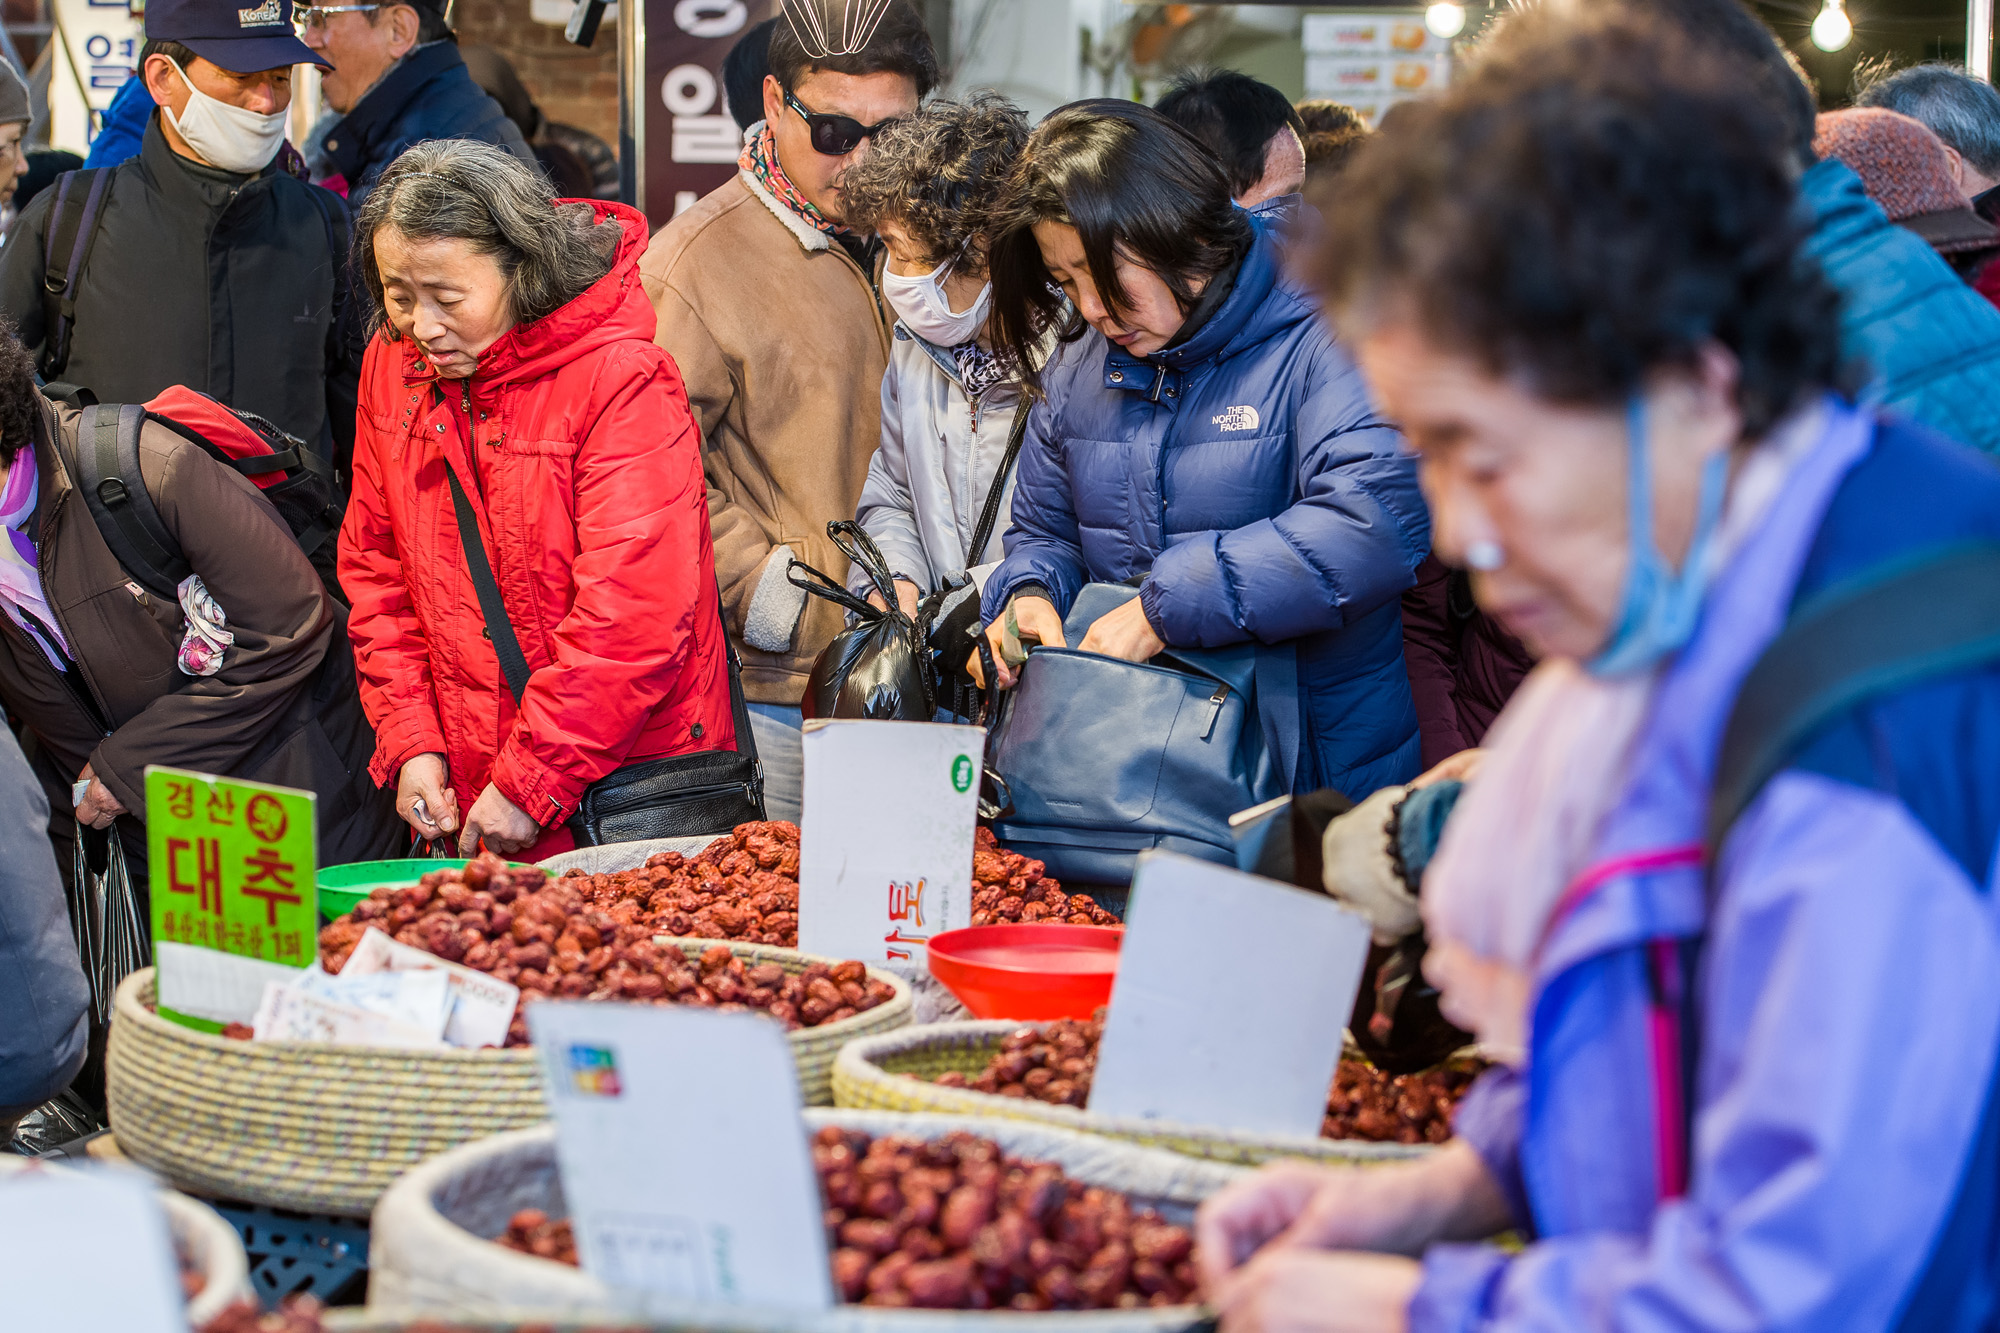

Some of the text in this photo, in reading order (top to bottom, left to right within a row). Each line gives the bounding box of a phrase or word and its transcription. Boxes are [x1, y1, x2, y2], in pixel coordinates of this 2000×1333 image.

[240, 9, 277, 21] KOREA
[1226, 405, 1245, 415] THE
[1212, 414, 1243, 425] NORTH
[1220, 422, 1244, 432] FACE
[165, 782, 236, 826] 경산
[165, 836, 303, 927] 대추
